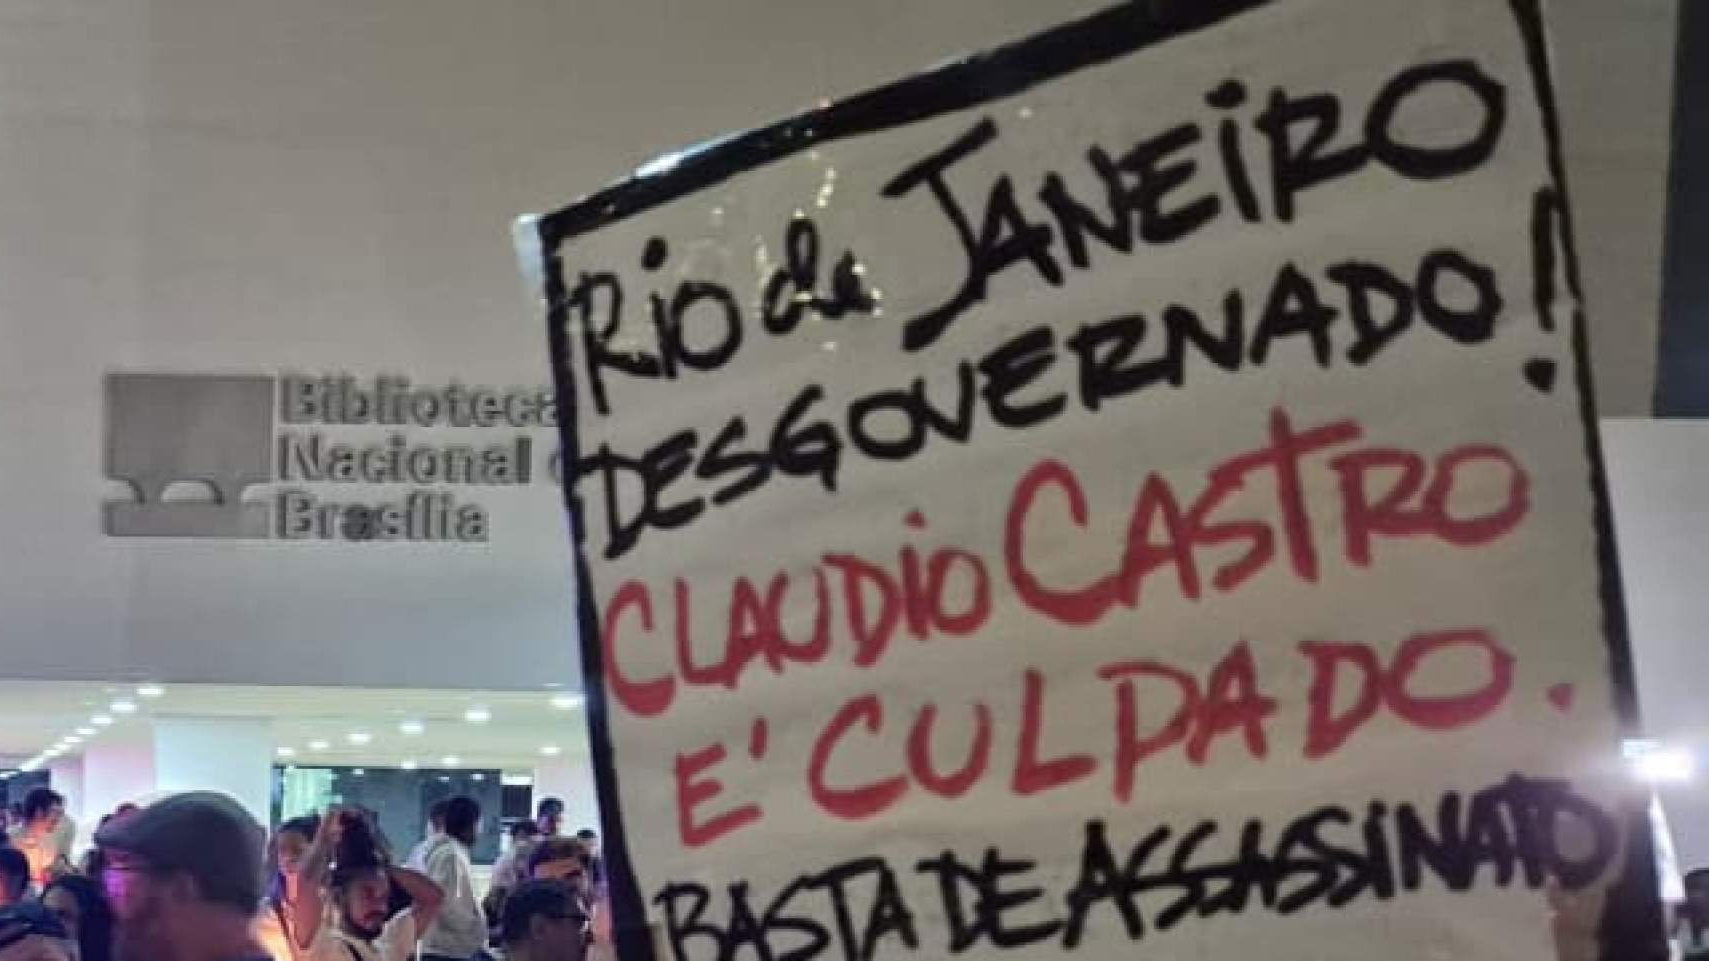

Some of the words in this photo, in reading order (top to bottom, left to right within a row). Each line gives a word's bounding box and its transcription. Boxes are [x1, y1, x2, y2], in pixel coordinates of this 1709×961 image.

[278, 374, 559, 427] Biblioteca
[277, 431, 533, 484] Nacional
[1004, 407, 1529, 625] CASTRO
[914, 846, 1067, 954] DE
